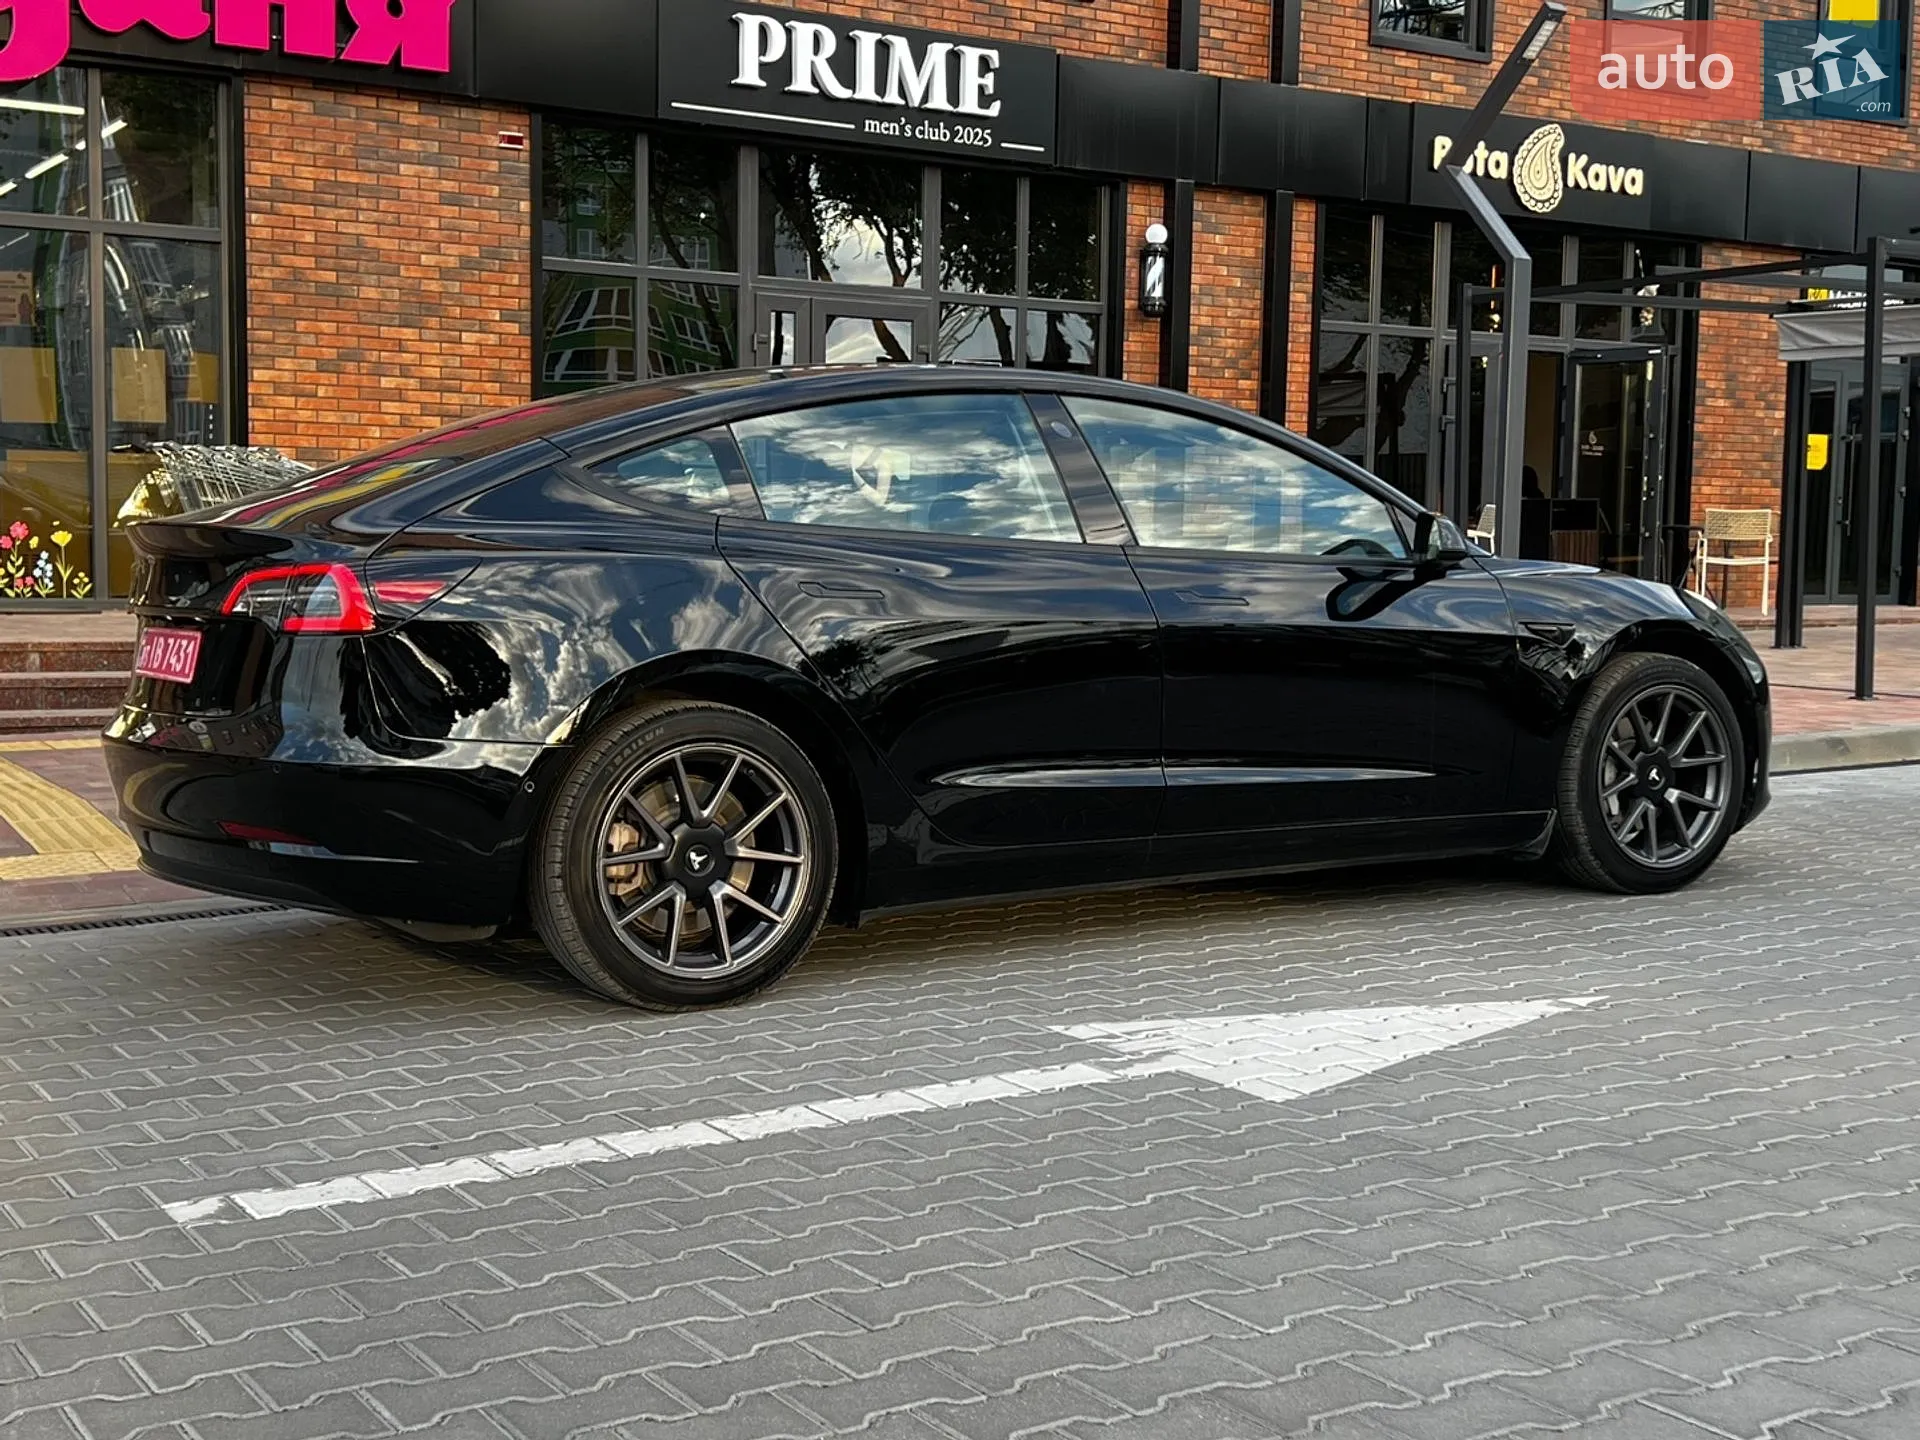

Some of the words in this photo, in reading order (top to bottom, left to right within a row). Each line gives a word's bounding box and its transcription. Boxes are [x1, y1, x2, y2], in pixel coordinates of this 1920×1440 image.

[731, 11, 1002, 118] PRIME
[915, 120, 951, 142] club
[953, 125, 992, 148] 2025
[1433, 134, 1509, 180] Pta
[1567, 152, 1644, 196] Kava
